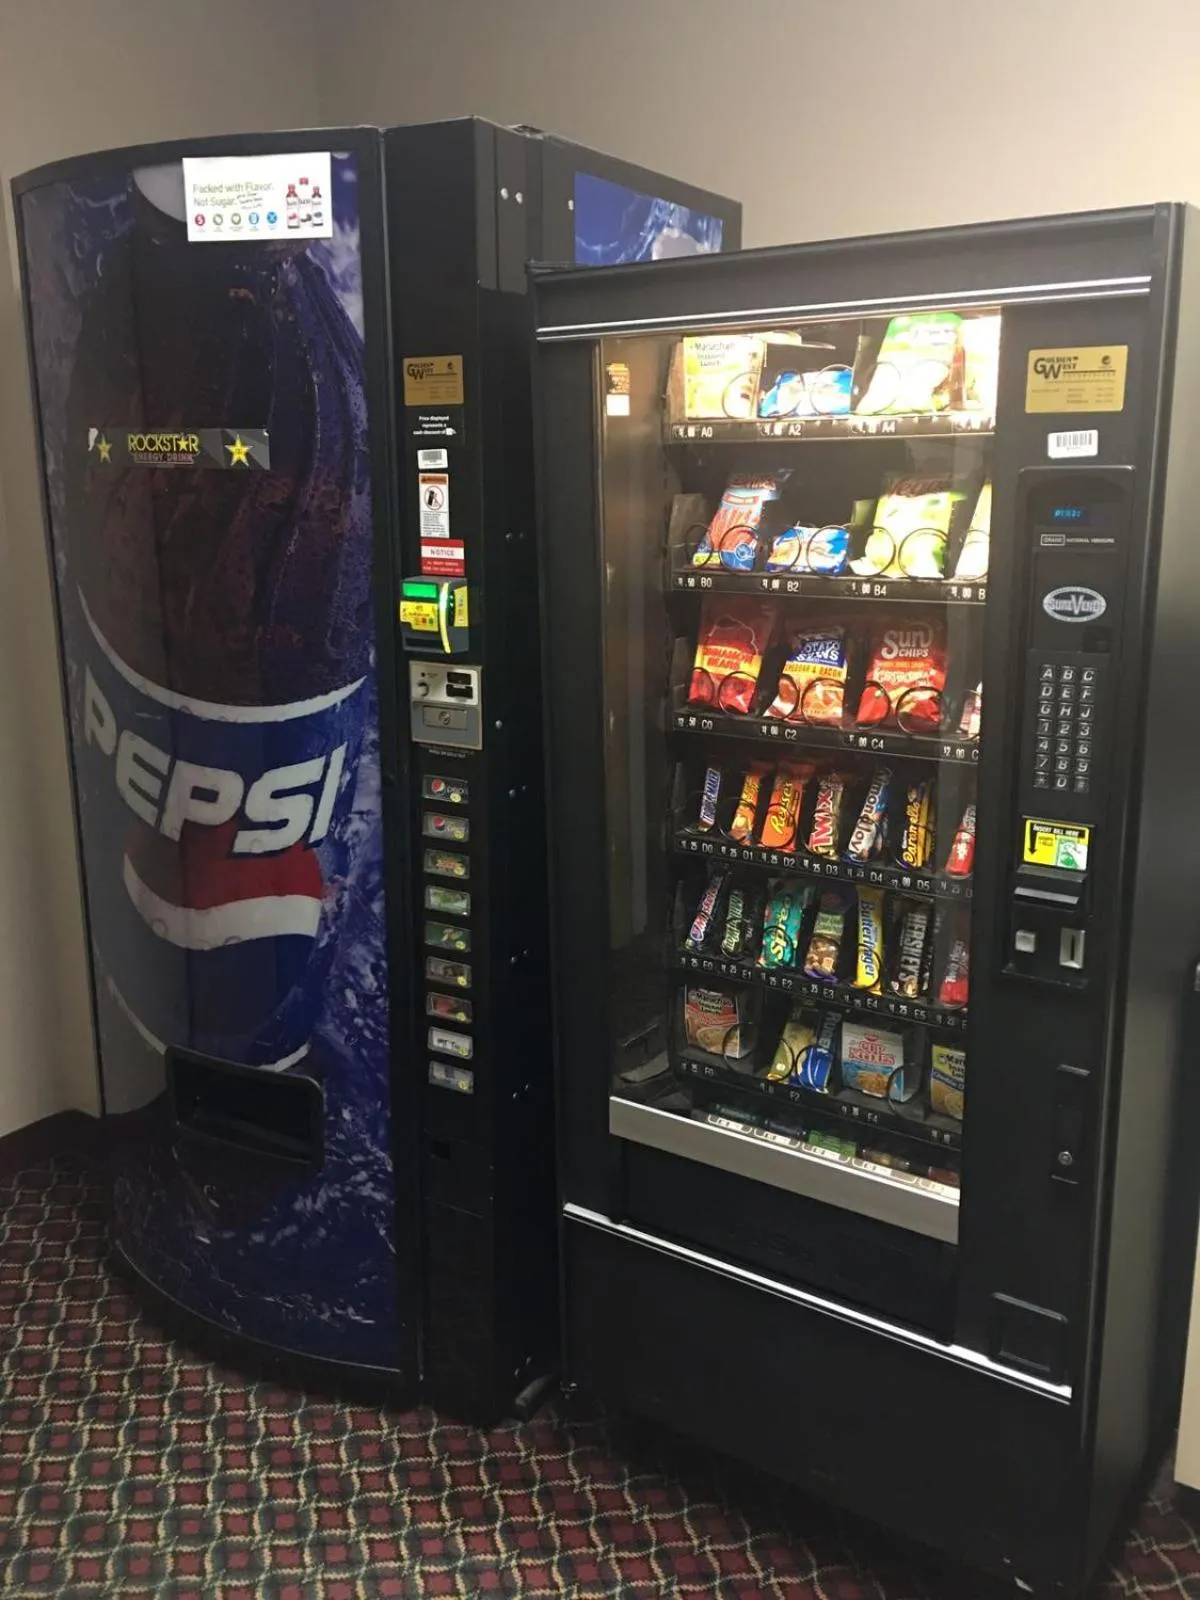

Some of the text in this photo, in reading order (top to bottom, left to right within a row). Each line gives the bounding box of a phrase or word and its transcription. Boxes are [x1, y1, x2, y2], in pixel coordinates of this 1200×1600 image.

[193, 183, 223, 193] Packed
[225, 183, 243, 193] with
[193, 197, 208, 207] Not
[801, 640, 840, 653] OTATO
[898, 648, 929, 657] CHIPS
[1043, 668, 1094, 681] A B C
[1041, 687, 1091, 699] D E F
[1060, 706, 1071, 716] H
[1081, 707, 1090, 718] J
[784, 728, 797, 740] C2
[1080, 726, 1089, 736] 3
[871, 738, 884, 750] C4
[1079, 744, 1088, 754] 6
[85, 663, 348, 854] PEPSI
